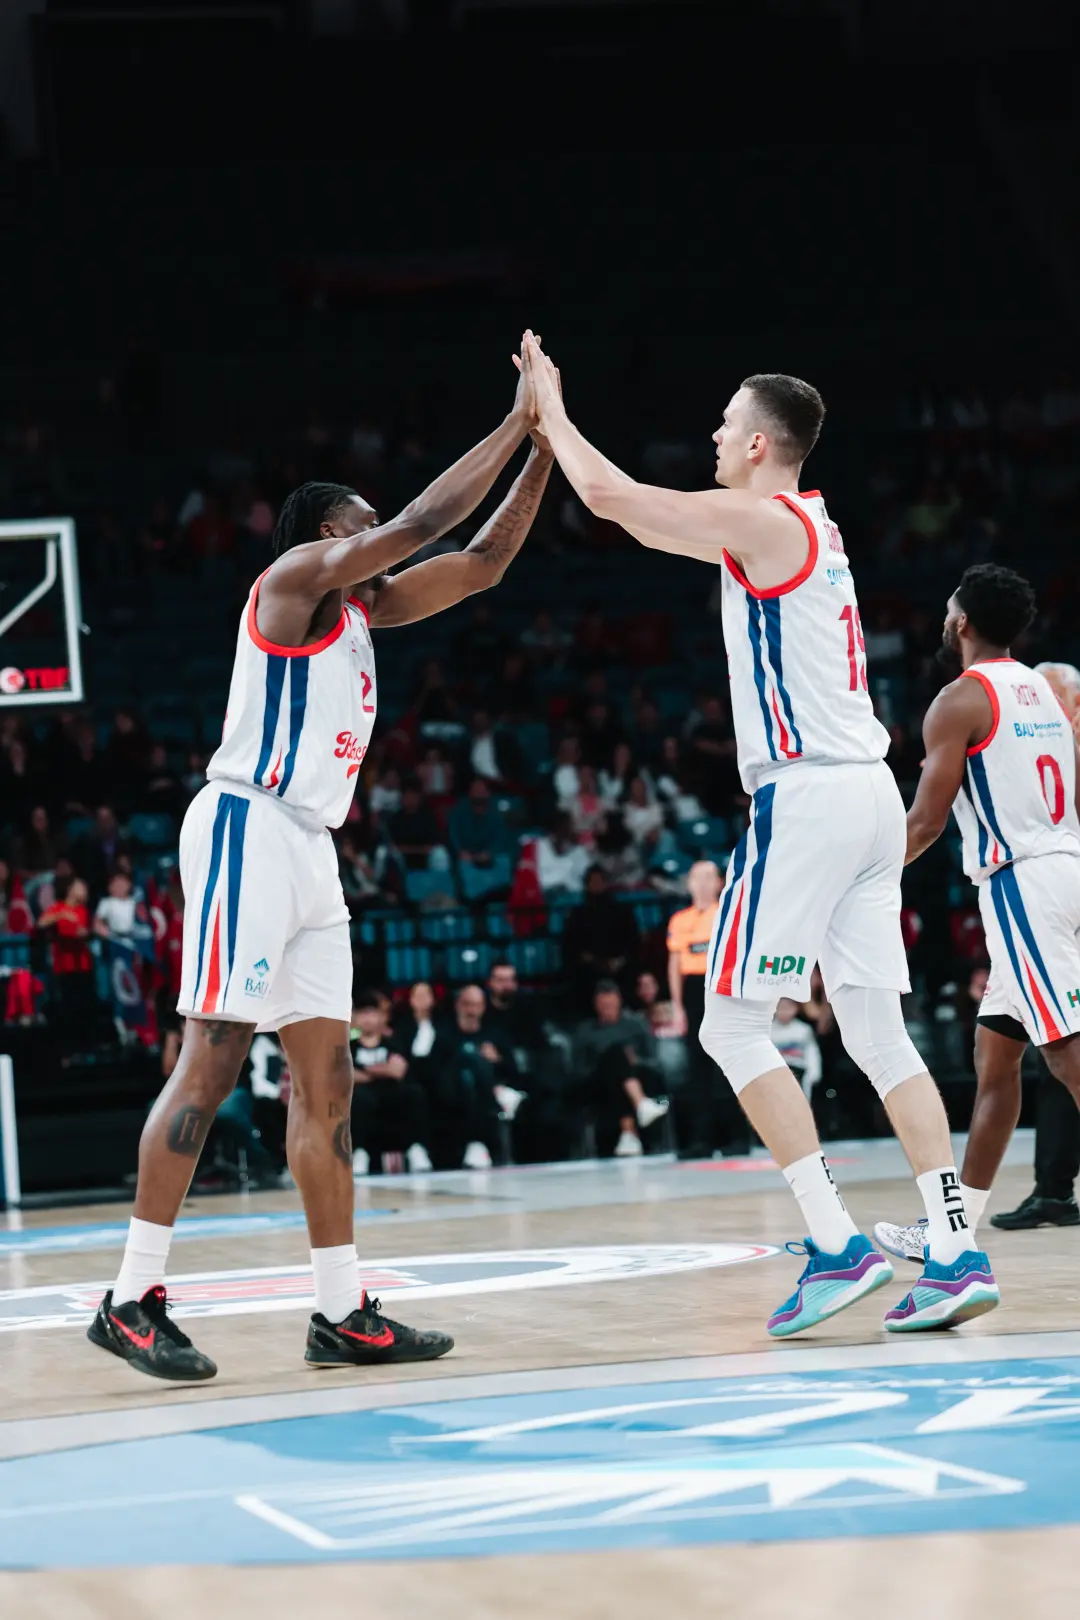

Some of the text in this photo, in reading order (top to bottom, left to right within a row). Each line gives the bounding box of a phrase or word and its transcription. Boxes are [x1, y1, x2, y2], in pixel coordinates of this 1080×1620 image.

[1013, 722, 1035, 738] BAU
[1036, 754, 1065, 825] 0
[758, 955, 806, 976] HDI
